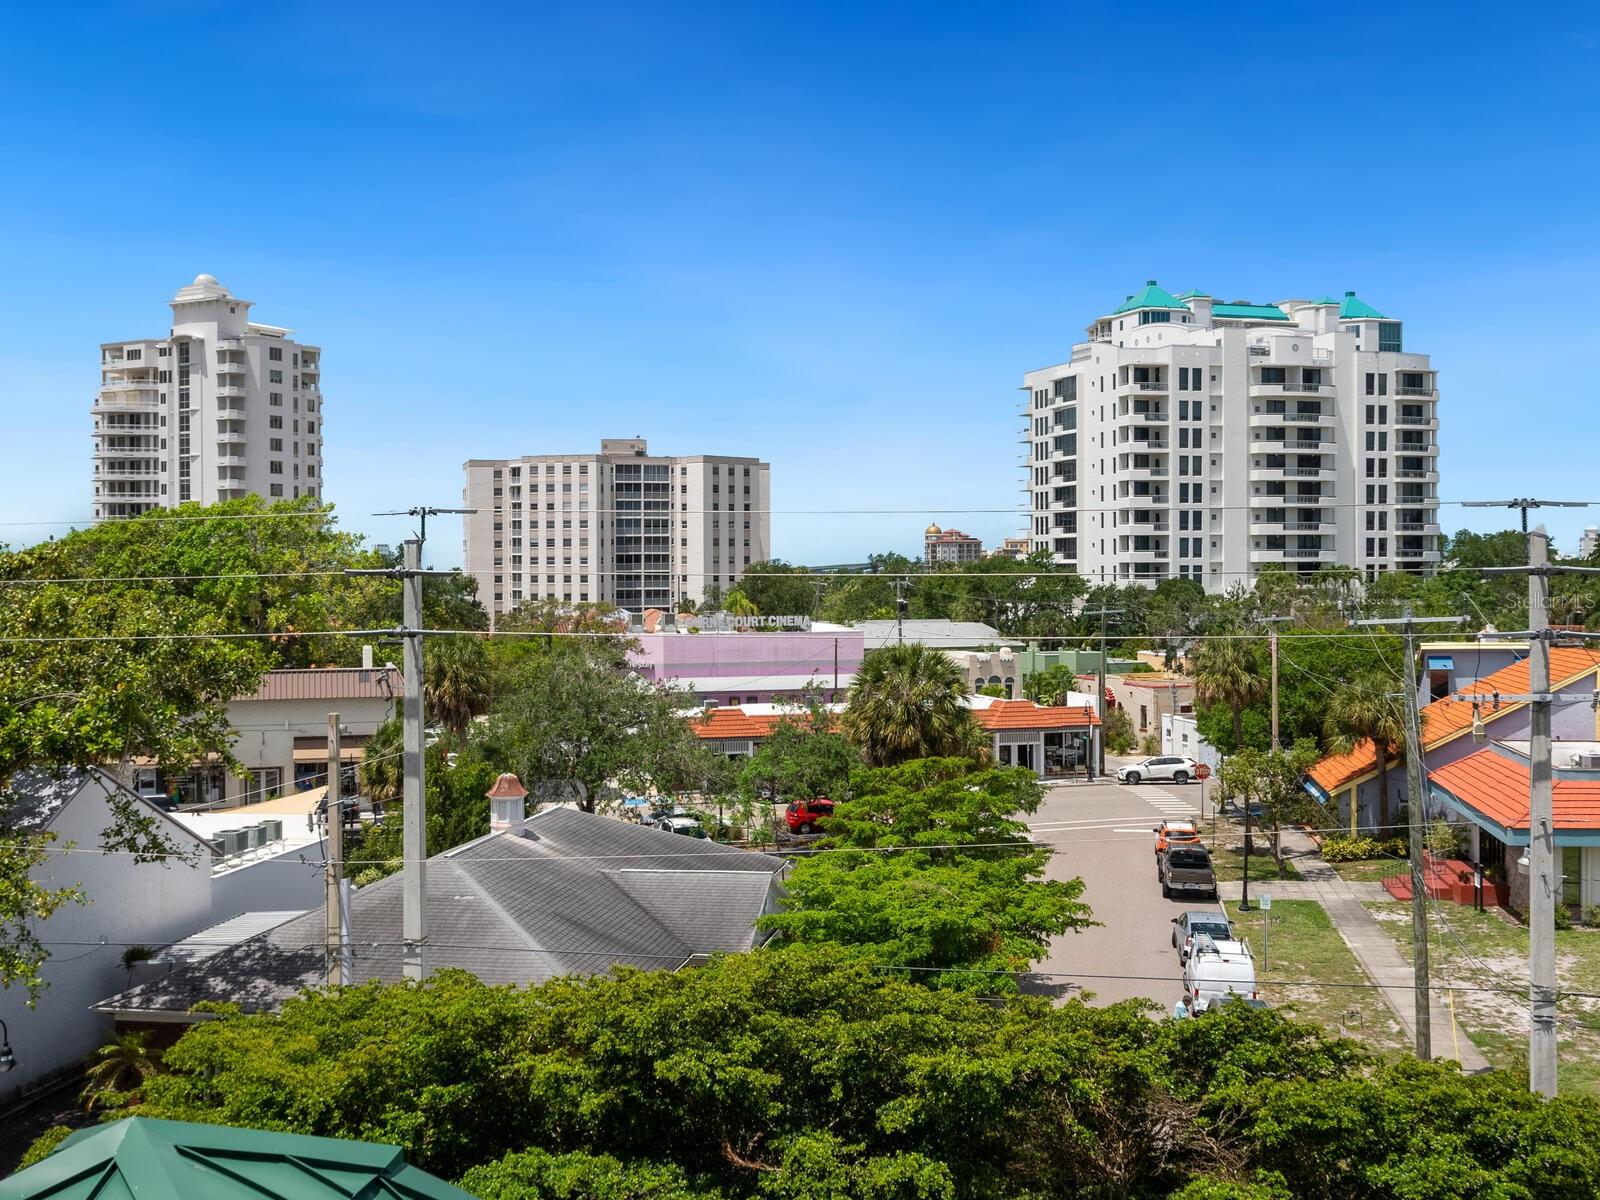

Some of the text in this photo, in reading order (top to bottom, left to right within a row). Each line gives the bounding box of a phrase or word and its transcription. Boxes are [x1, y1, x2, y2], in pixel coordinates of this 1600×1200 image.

[726, 615, 766, 628] COURT
[767, 615, 812, 628] CINEMA
[1195, 768, 1210, 776] STOP
